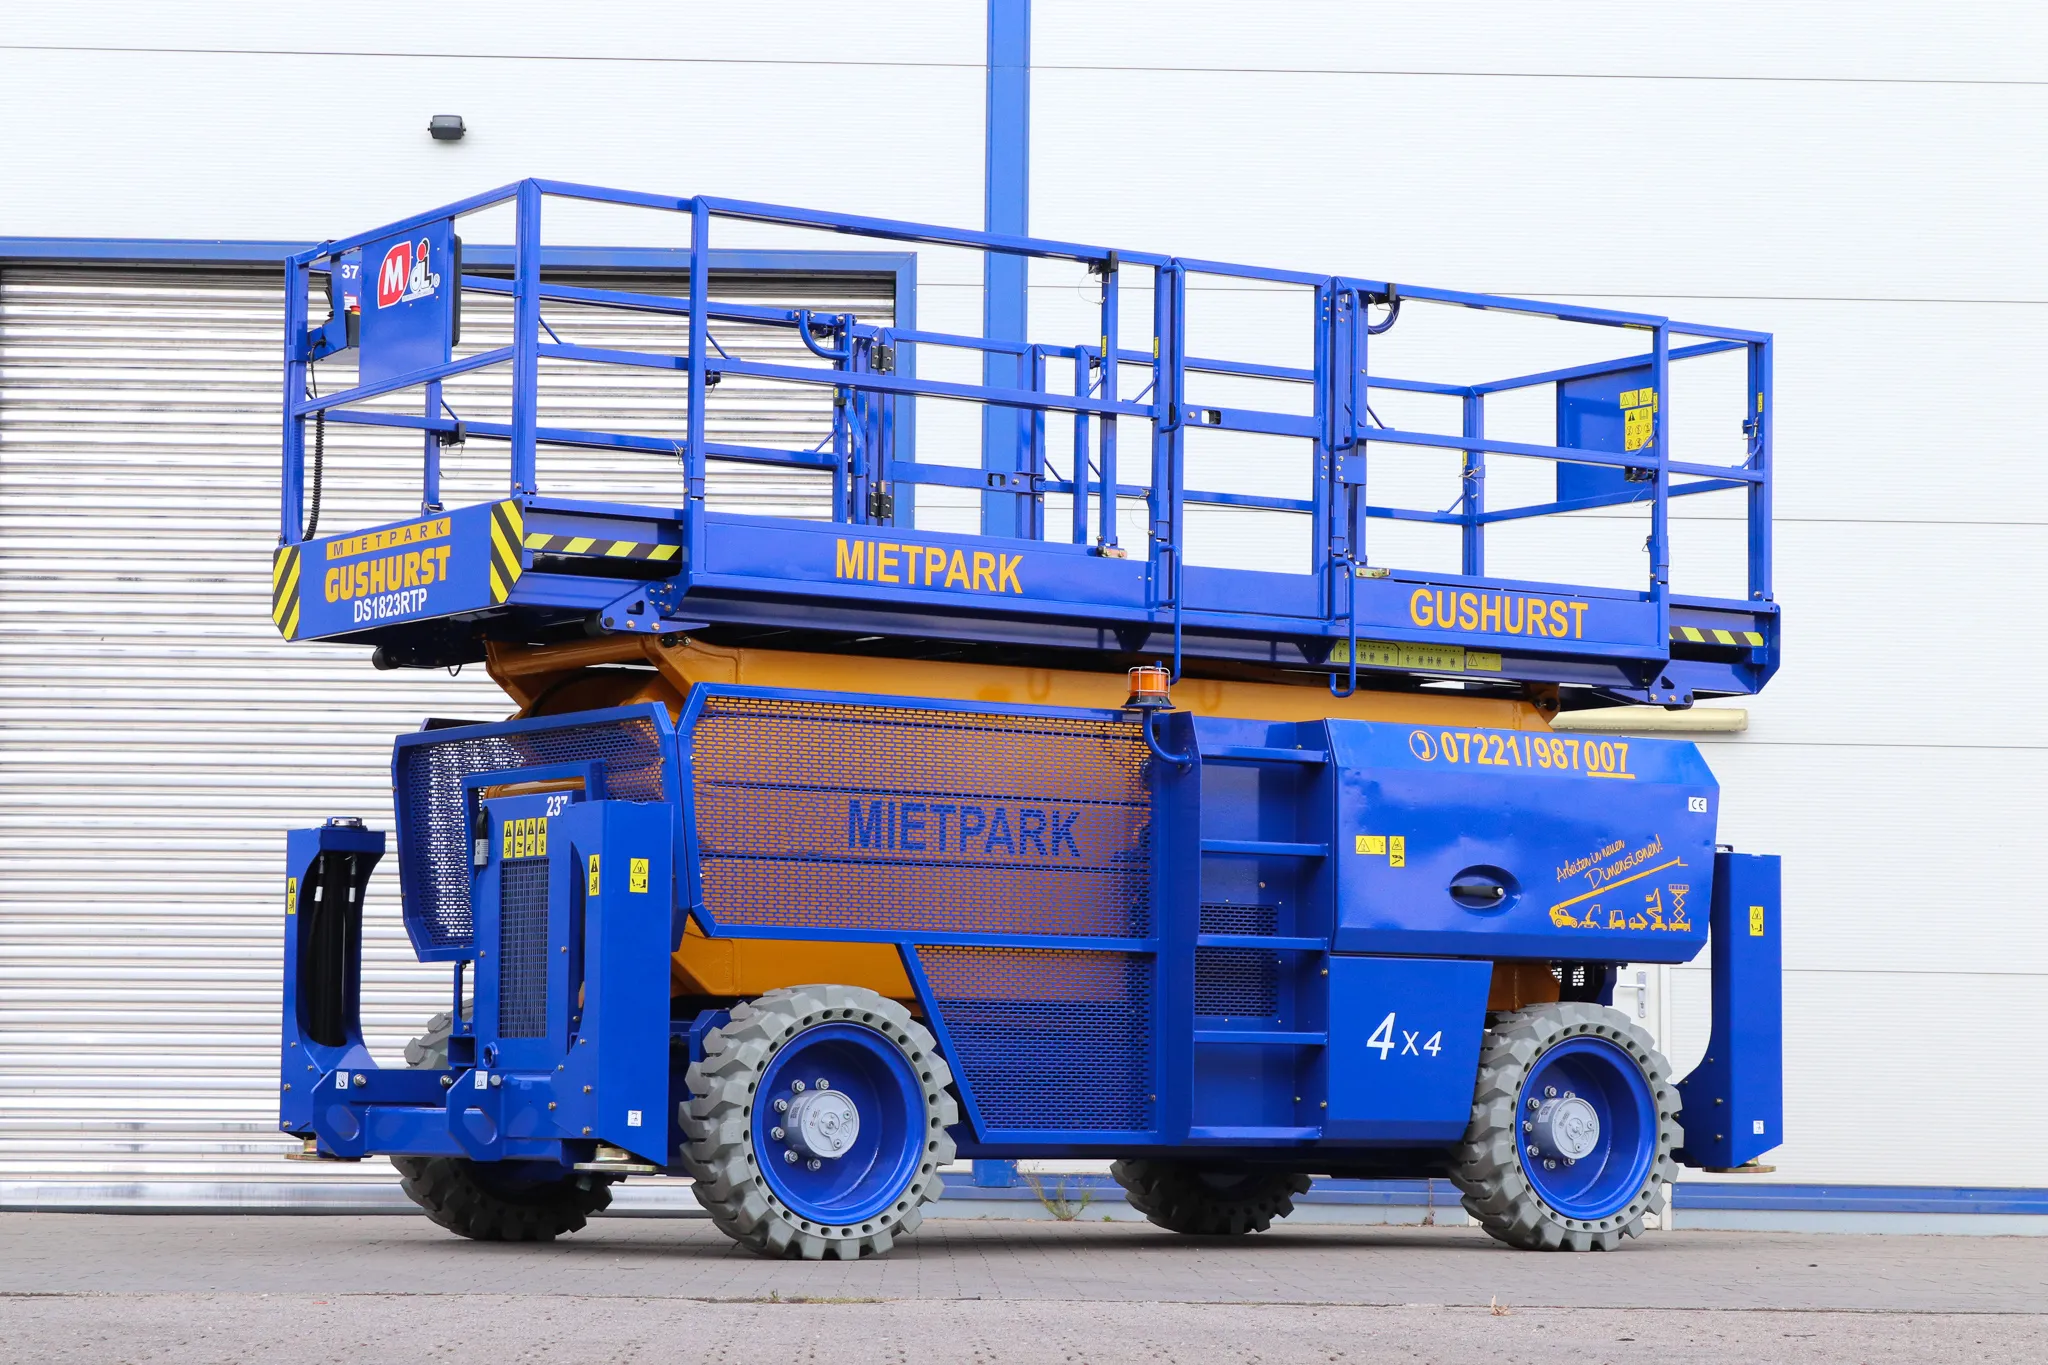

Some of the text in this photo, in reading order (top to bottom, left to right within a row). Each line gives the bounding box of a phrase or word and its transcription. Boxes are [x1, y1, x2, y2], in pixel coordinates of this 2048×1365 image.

[341, 264, 360, 280] 37
[333, 522, 444, 556] MIETPARK
[325, 545, 451, 602] GUSHURST
[836, 538, 1023, 594] MIETPARK
[354, 589, 427, 623] DS1823RTP
[1410, 588, 1588, 639] GUSHURST
[848, 799, 1082, 858] MIETPARK
[1584, 833, 1664, 889] Dimensionen!
